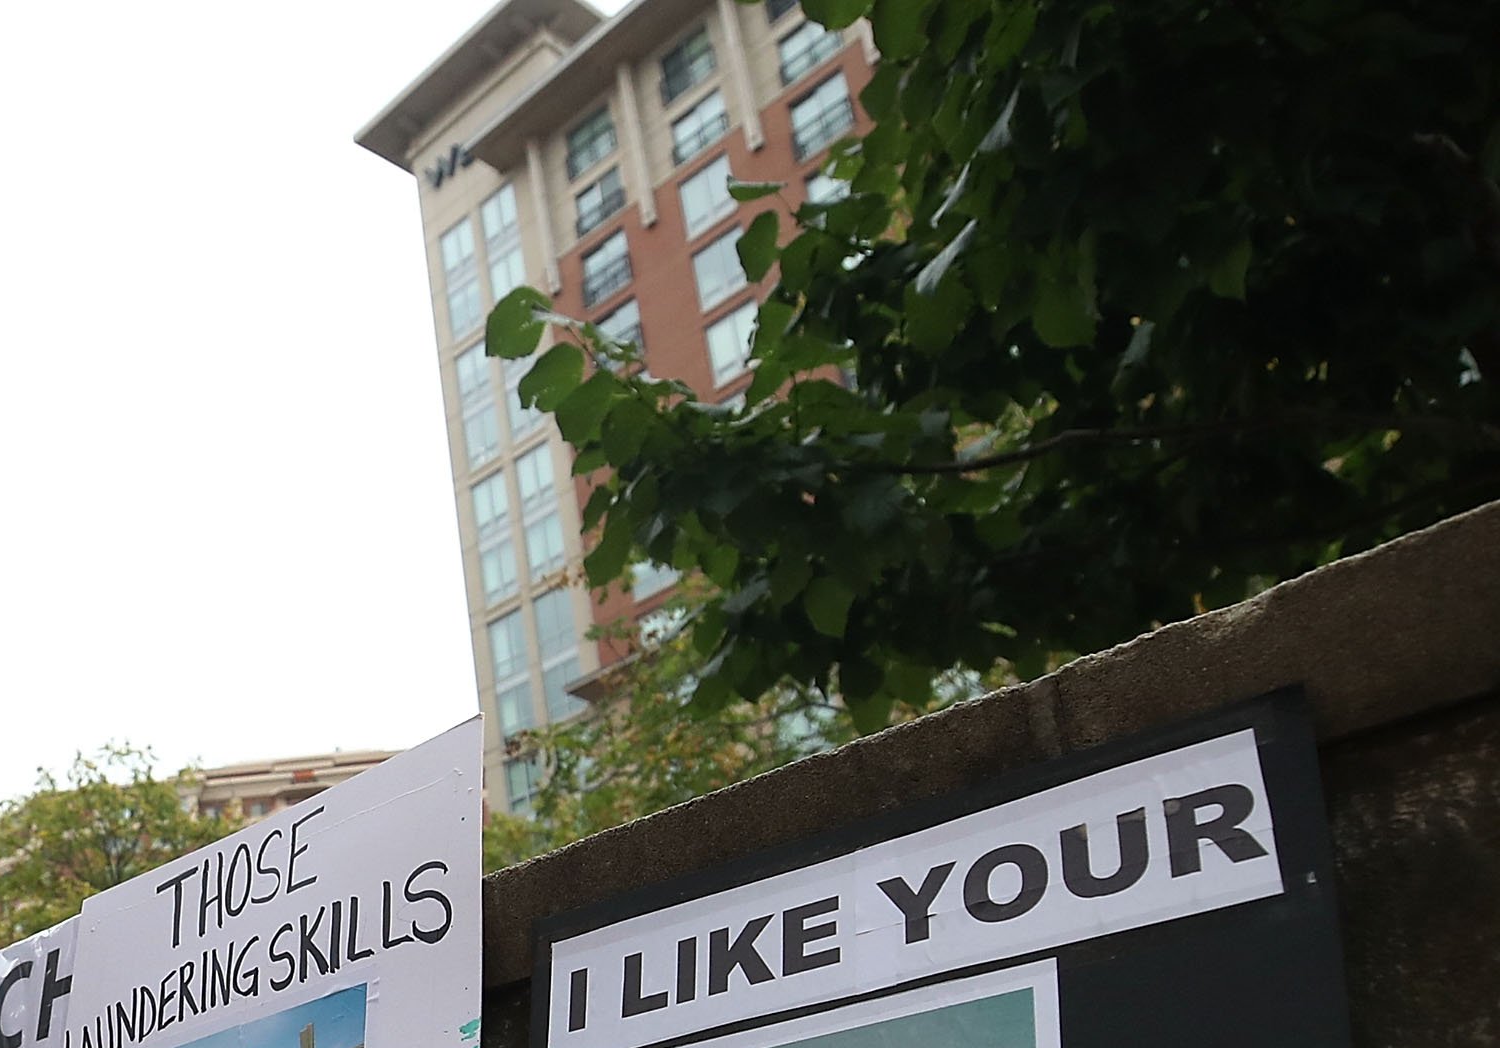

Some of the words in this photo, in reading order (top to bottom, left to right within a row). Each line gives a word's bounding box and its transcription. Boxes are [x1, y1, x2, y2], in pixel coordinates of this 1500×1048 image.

[155, 805, 325, 949] THOSE
[268, 860, 453, 991] SKILLS
[568, 968, 589, 1033] I
[621, 895, 842, 1020] LIKE
[876, 782, 1271, 946] YOUR
